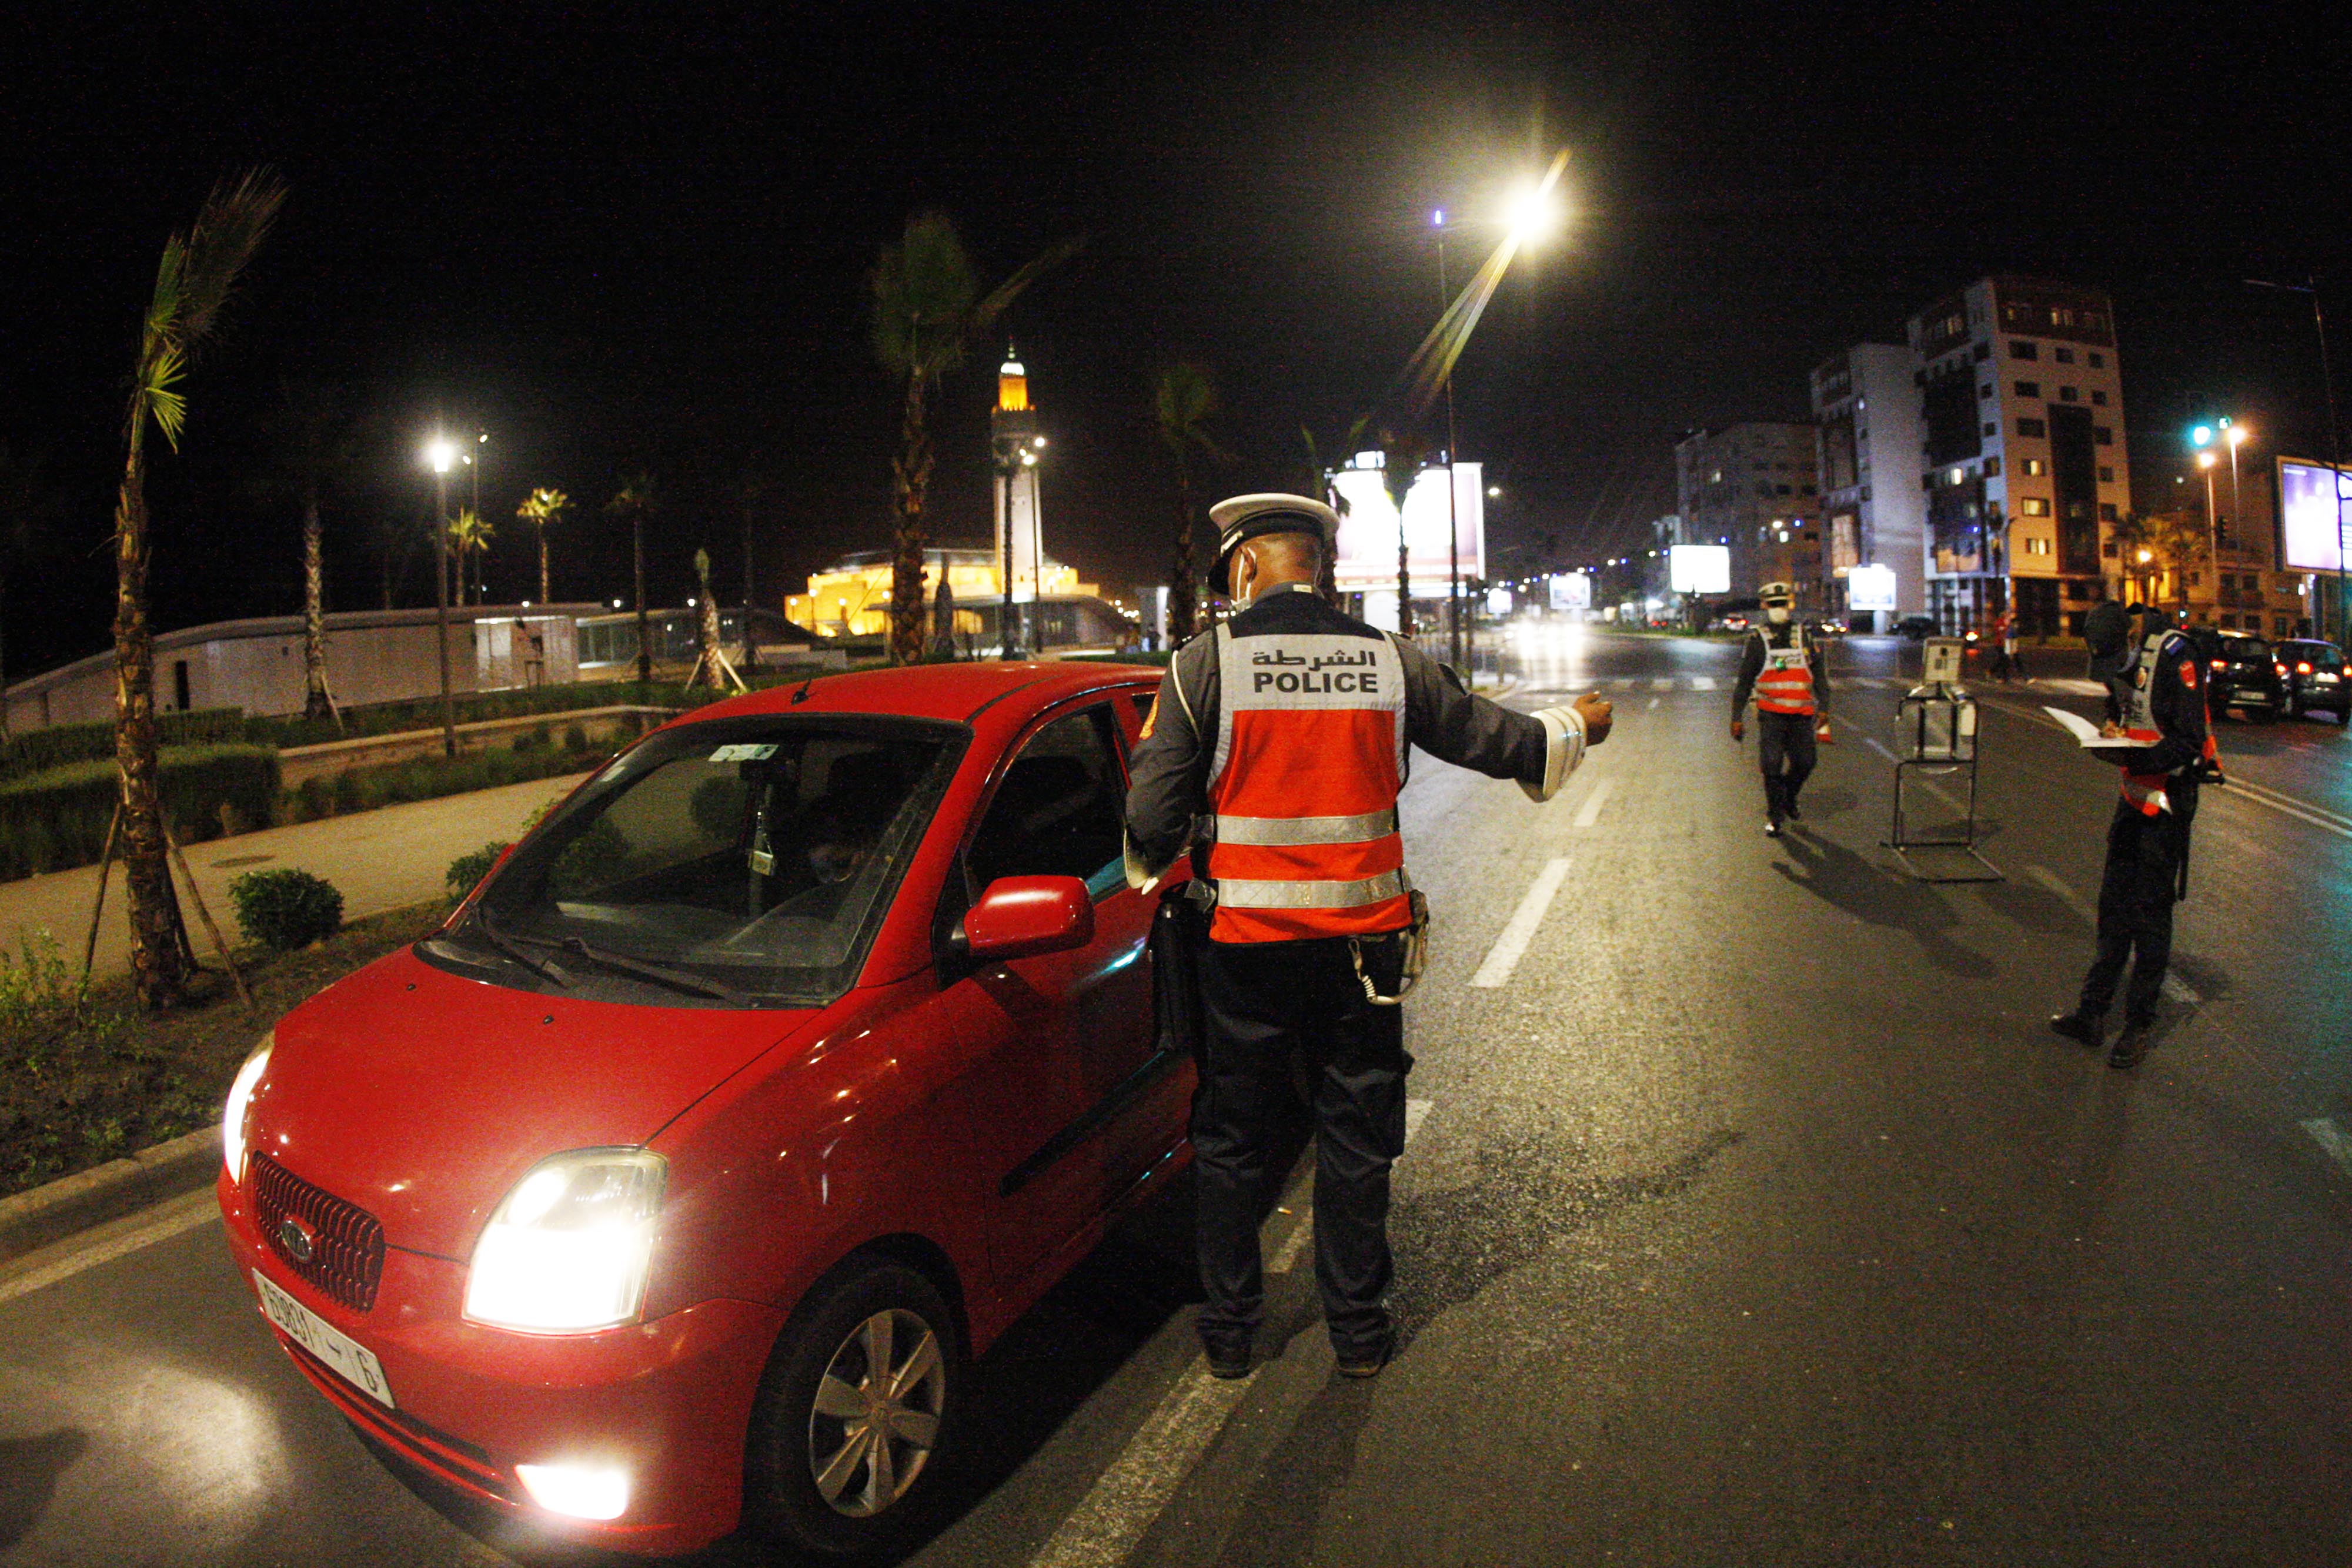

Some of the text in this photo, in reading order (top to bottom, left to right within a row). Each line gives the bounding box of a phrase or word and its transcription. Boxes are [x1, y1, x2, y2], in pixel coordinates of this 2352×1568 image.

[1252, 650, 1376, 671] الشرطة
[1254, 672, 1378, 693] POLICE
[356, 1350, 378, 1393] 6
